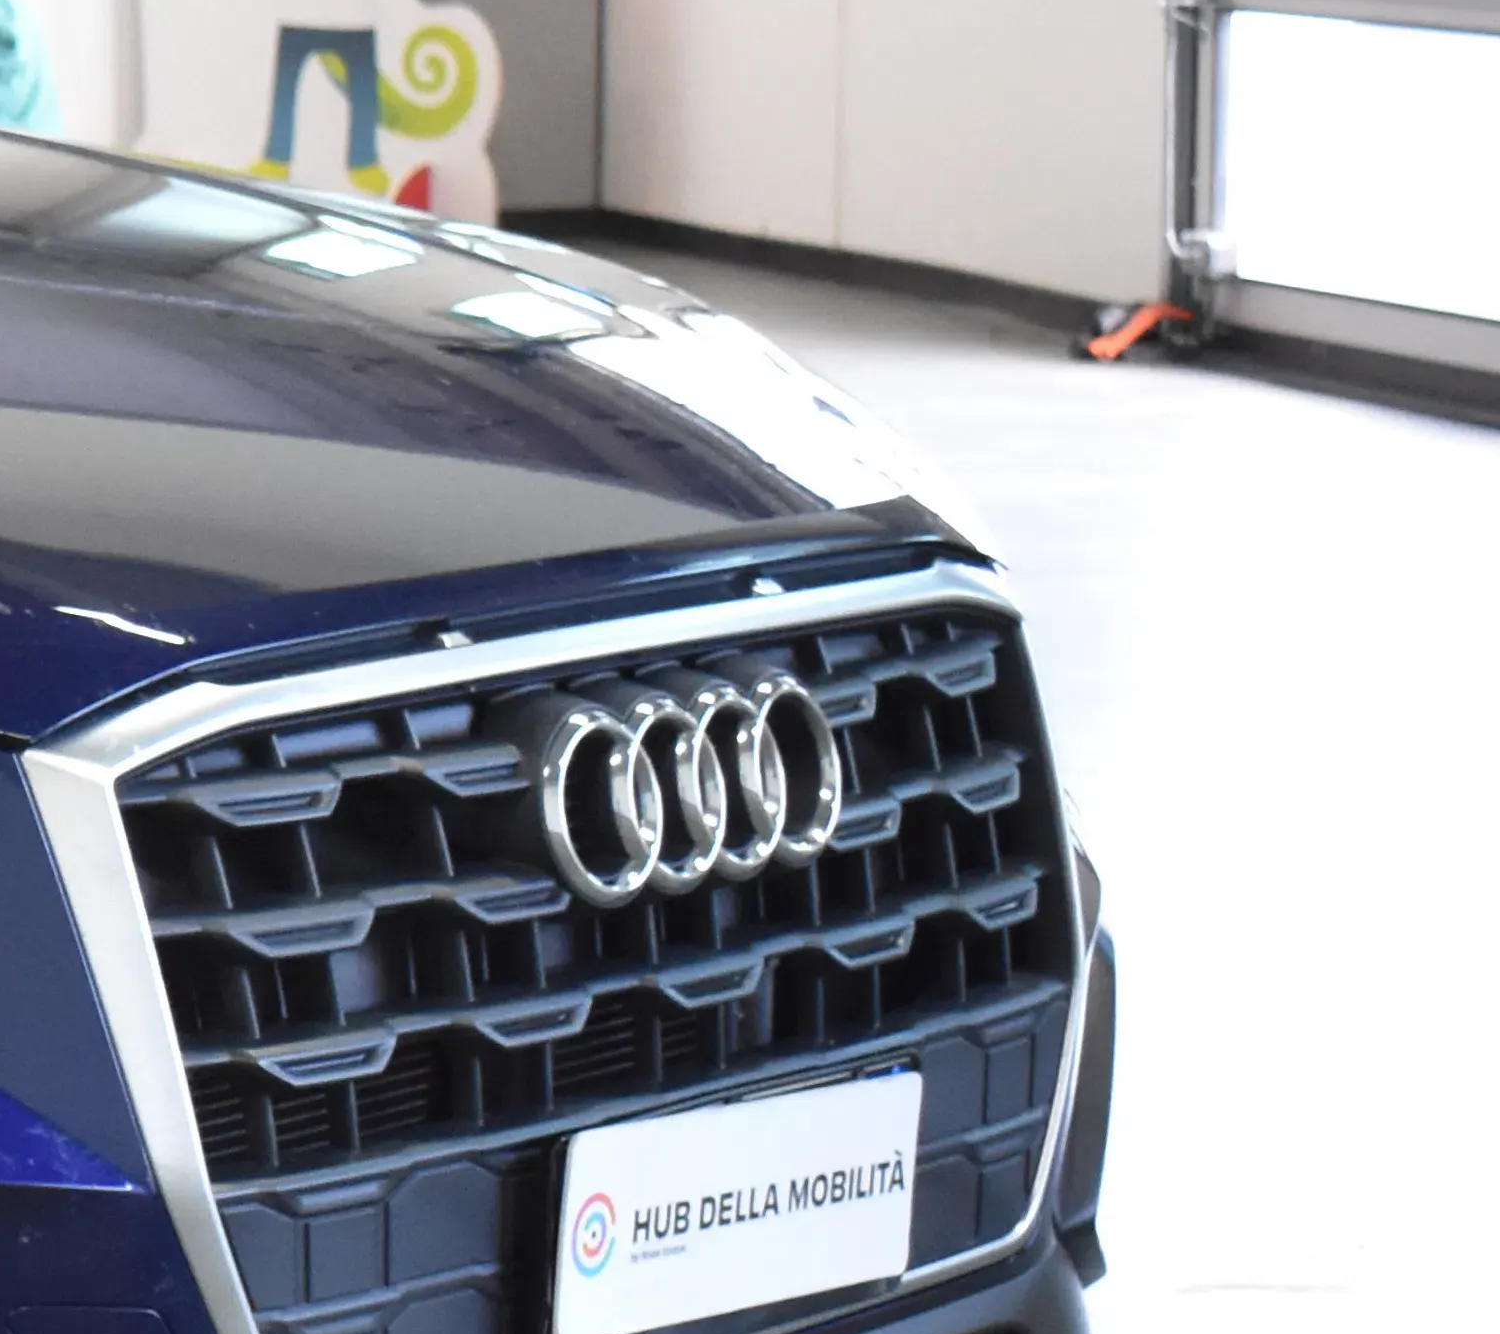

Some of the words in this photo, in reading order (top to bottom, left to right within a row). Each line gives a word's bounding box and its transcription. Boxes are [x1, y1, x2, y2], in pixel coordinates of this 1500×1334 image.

[632, 1200, 691, 1246] HUB
[699, 1182, 780, 1231] DELLA
[788, 1149, 906, 1213] MOBILITÀ
